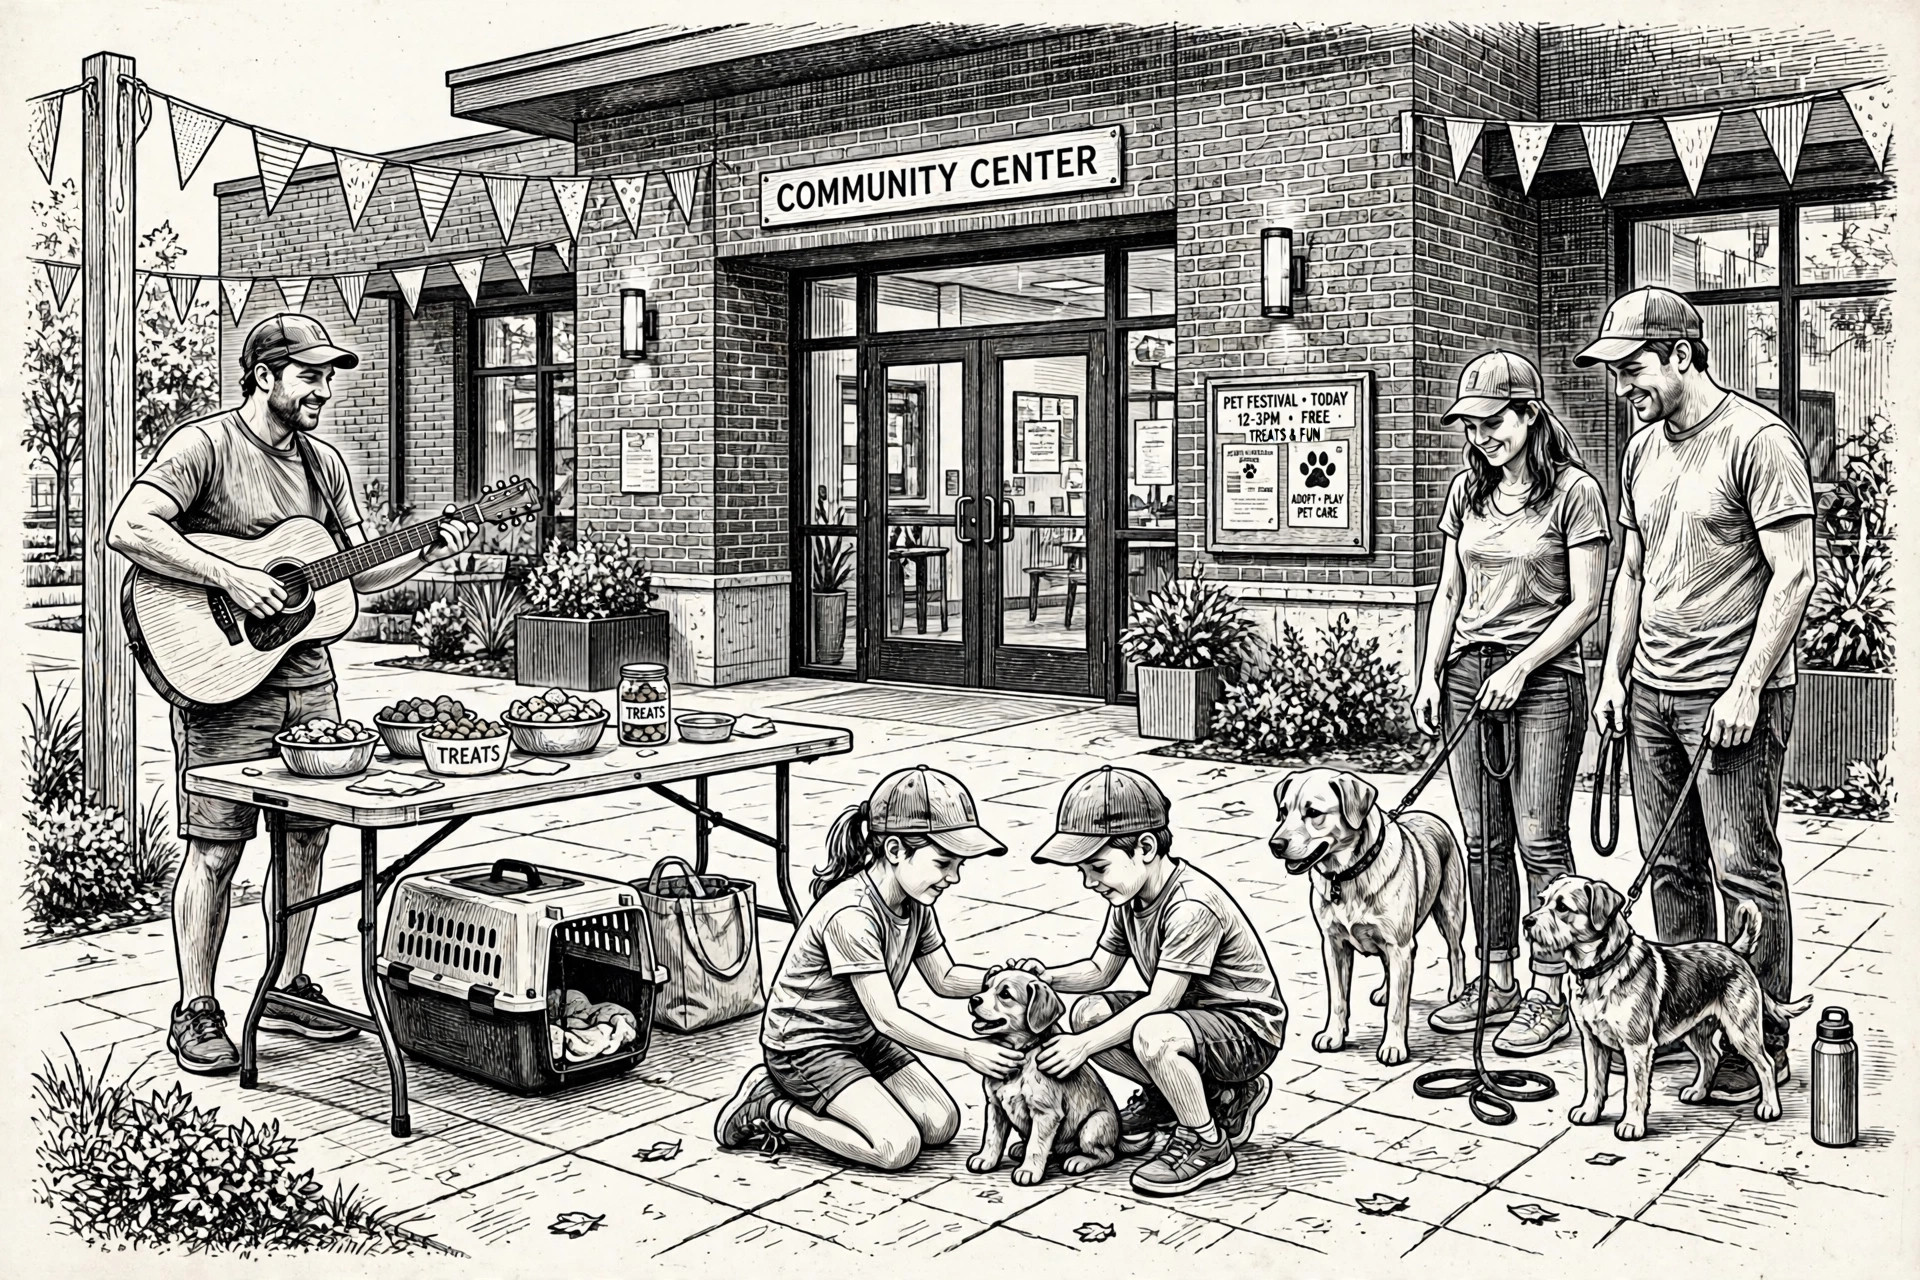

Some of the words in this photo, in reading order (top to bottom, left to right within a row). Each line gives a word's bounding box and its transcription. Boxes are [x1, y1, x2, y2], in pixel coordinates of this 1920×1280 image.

[776, 161, 958, 212] COMMUNITY
[970, 144, 1098, 188] CENTER
[1223, 395, 1244, 410] PET
[1247, 393, 1299, 409] FESTIVAL
[1311, 391, 1349, 406] TODAY
[1237, 411, 1281, 427] 12-3PM
[1301, 409, 1331, 424] FREE
[1249, 427, 1287, 443] TREATS
[1289, 428, 1297, 441] &
[1300, 427, 1321, 441] FUN
[1291, 493, 1317, 505] ADOPT
[1323, 493, 1345, 505] PLAY
[1297, 506, 1314, 519] PET
[1315, 506, 1339, 519] CARE
[625, 705, 666, 720] TREATS
[437, 744, 500, 765] TREATS
